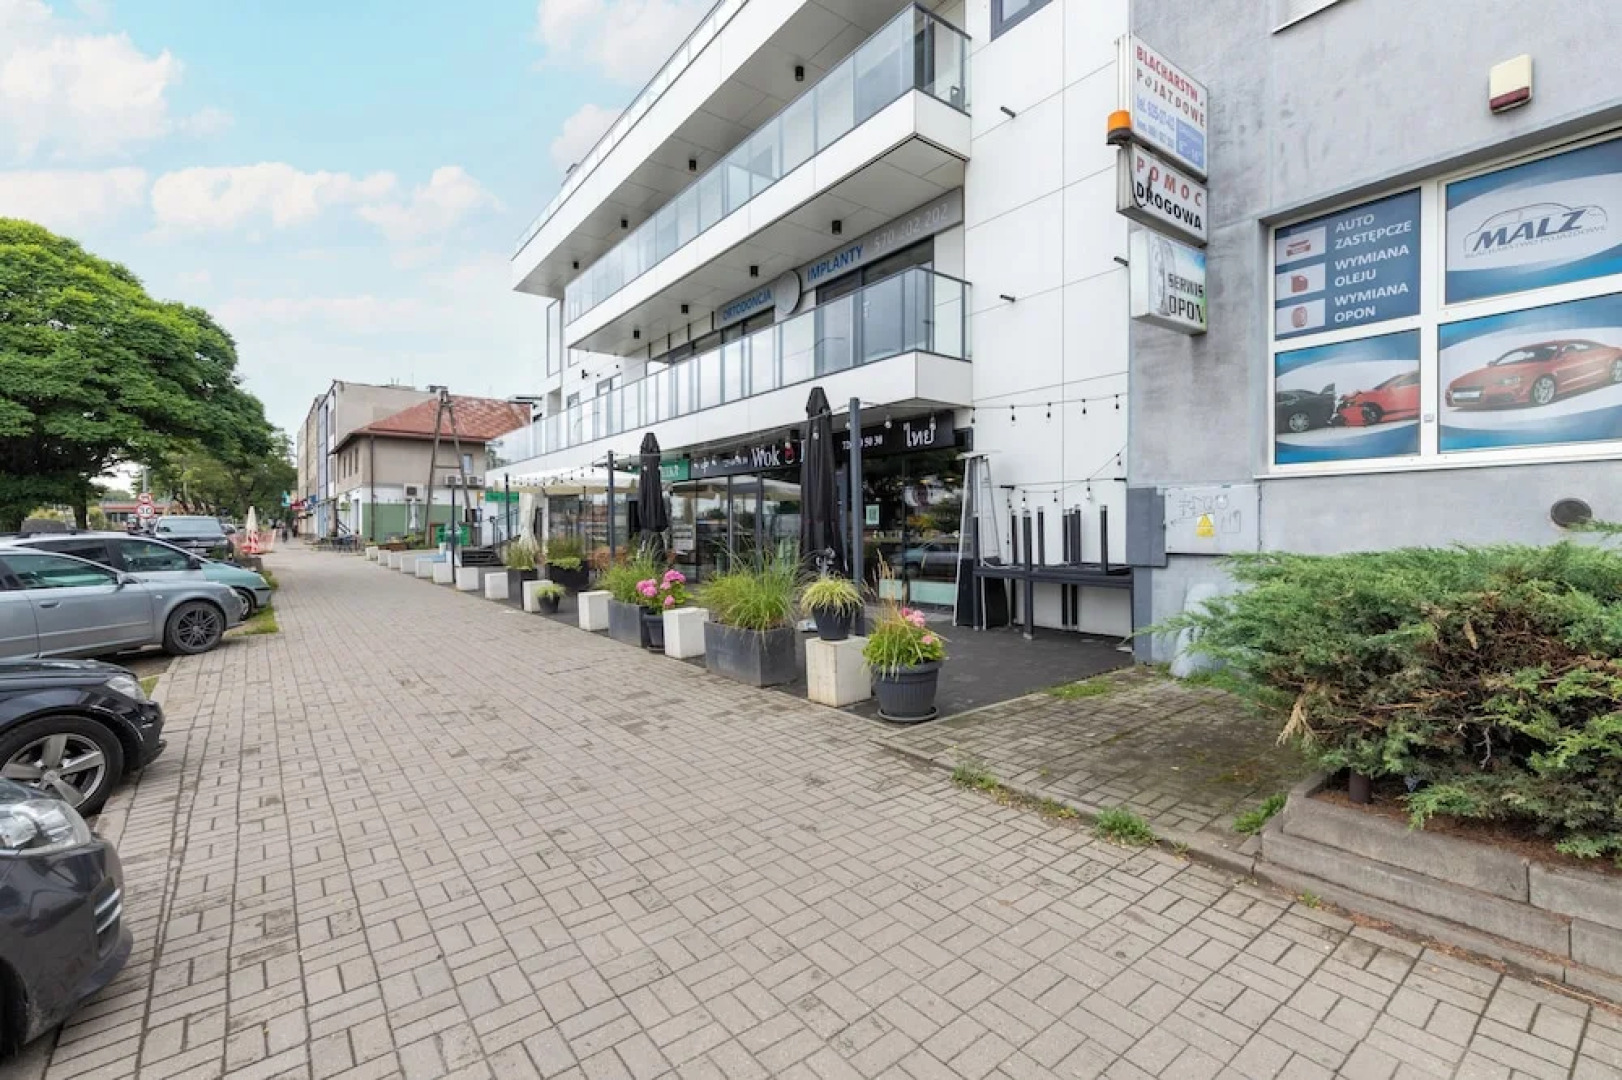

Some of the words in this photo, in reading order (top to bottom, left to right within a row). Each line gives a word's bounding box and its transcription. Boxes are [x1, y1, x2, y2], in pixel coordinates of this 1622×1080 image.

[1137, 45, 1204, 107] BLACHARSTW
[1136, 155, 1202, 207] POMOC
[1136, 181, 1202, 231] DROGOWA
[1334, 220, 1412, 249] ZASTĘPCZE
[1335, 213, 1375, 234] AUTO
[1472, 208, 1587, 252] MALZ
[807, 244, 863, 282] IMPLANTY
[1334, 244, 1409, 270] WYMIANA
[1168, 273, 1204, 298] SERWIS
[1334, 268, 1377, 288] OLEJU
[723, 288, 771, 320] ORTODONCJA
[1169, 294, 1204, 323] OPON
[1334, 282, 1409, 306] WYMIANA
[1334, 305, 1376, 323] OPON
[751, 443, 780, 468] Wok
